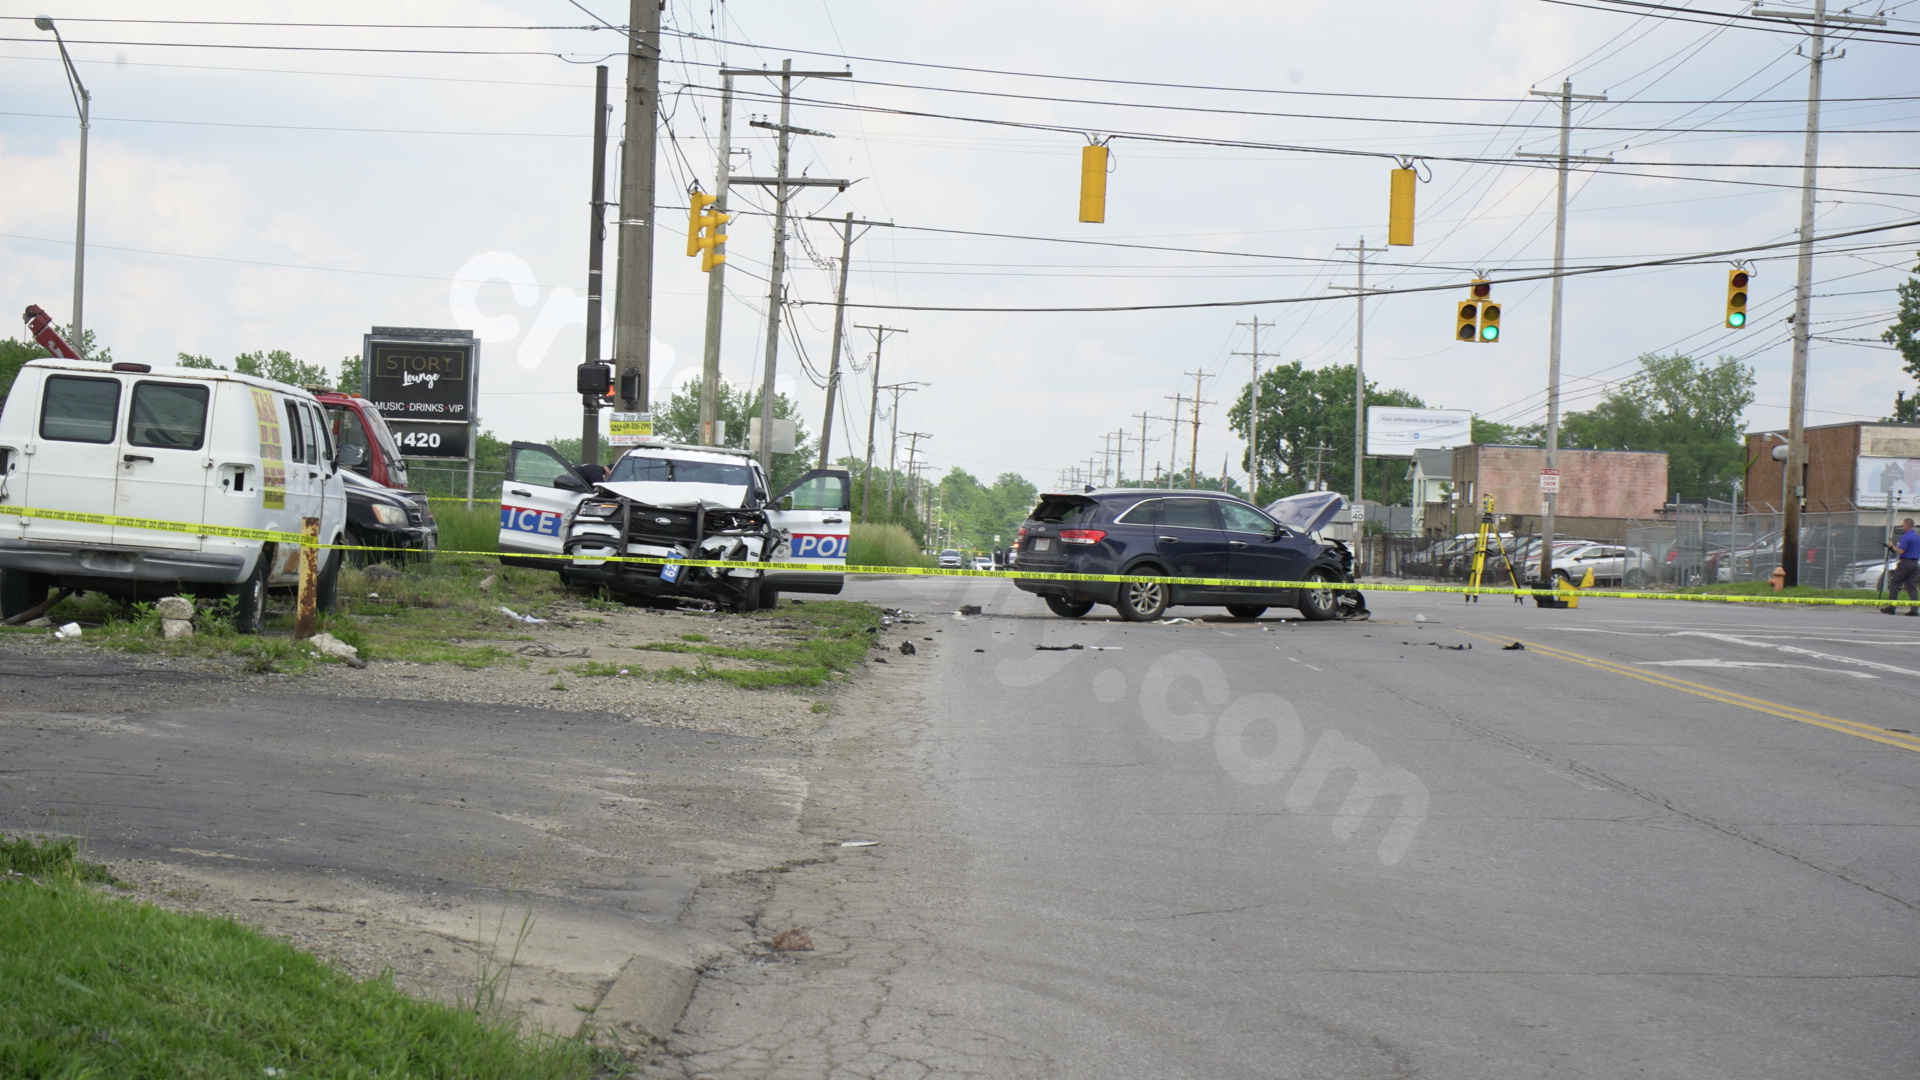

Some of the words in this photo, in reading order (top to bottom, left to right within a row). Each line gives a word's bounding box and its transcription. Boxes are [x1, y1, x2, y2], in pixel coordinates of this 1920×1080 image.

[402, 370, 440, 389] Lounge
[375, 401, 405, 411] MUSIC
[409, 402, 444, 413] DRINKS
[448, 404, 464, 413] VIP
[393, 432, 441, 448] 1420
